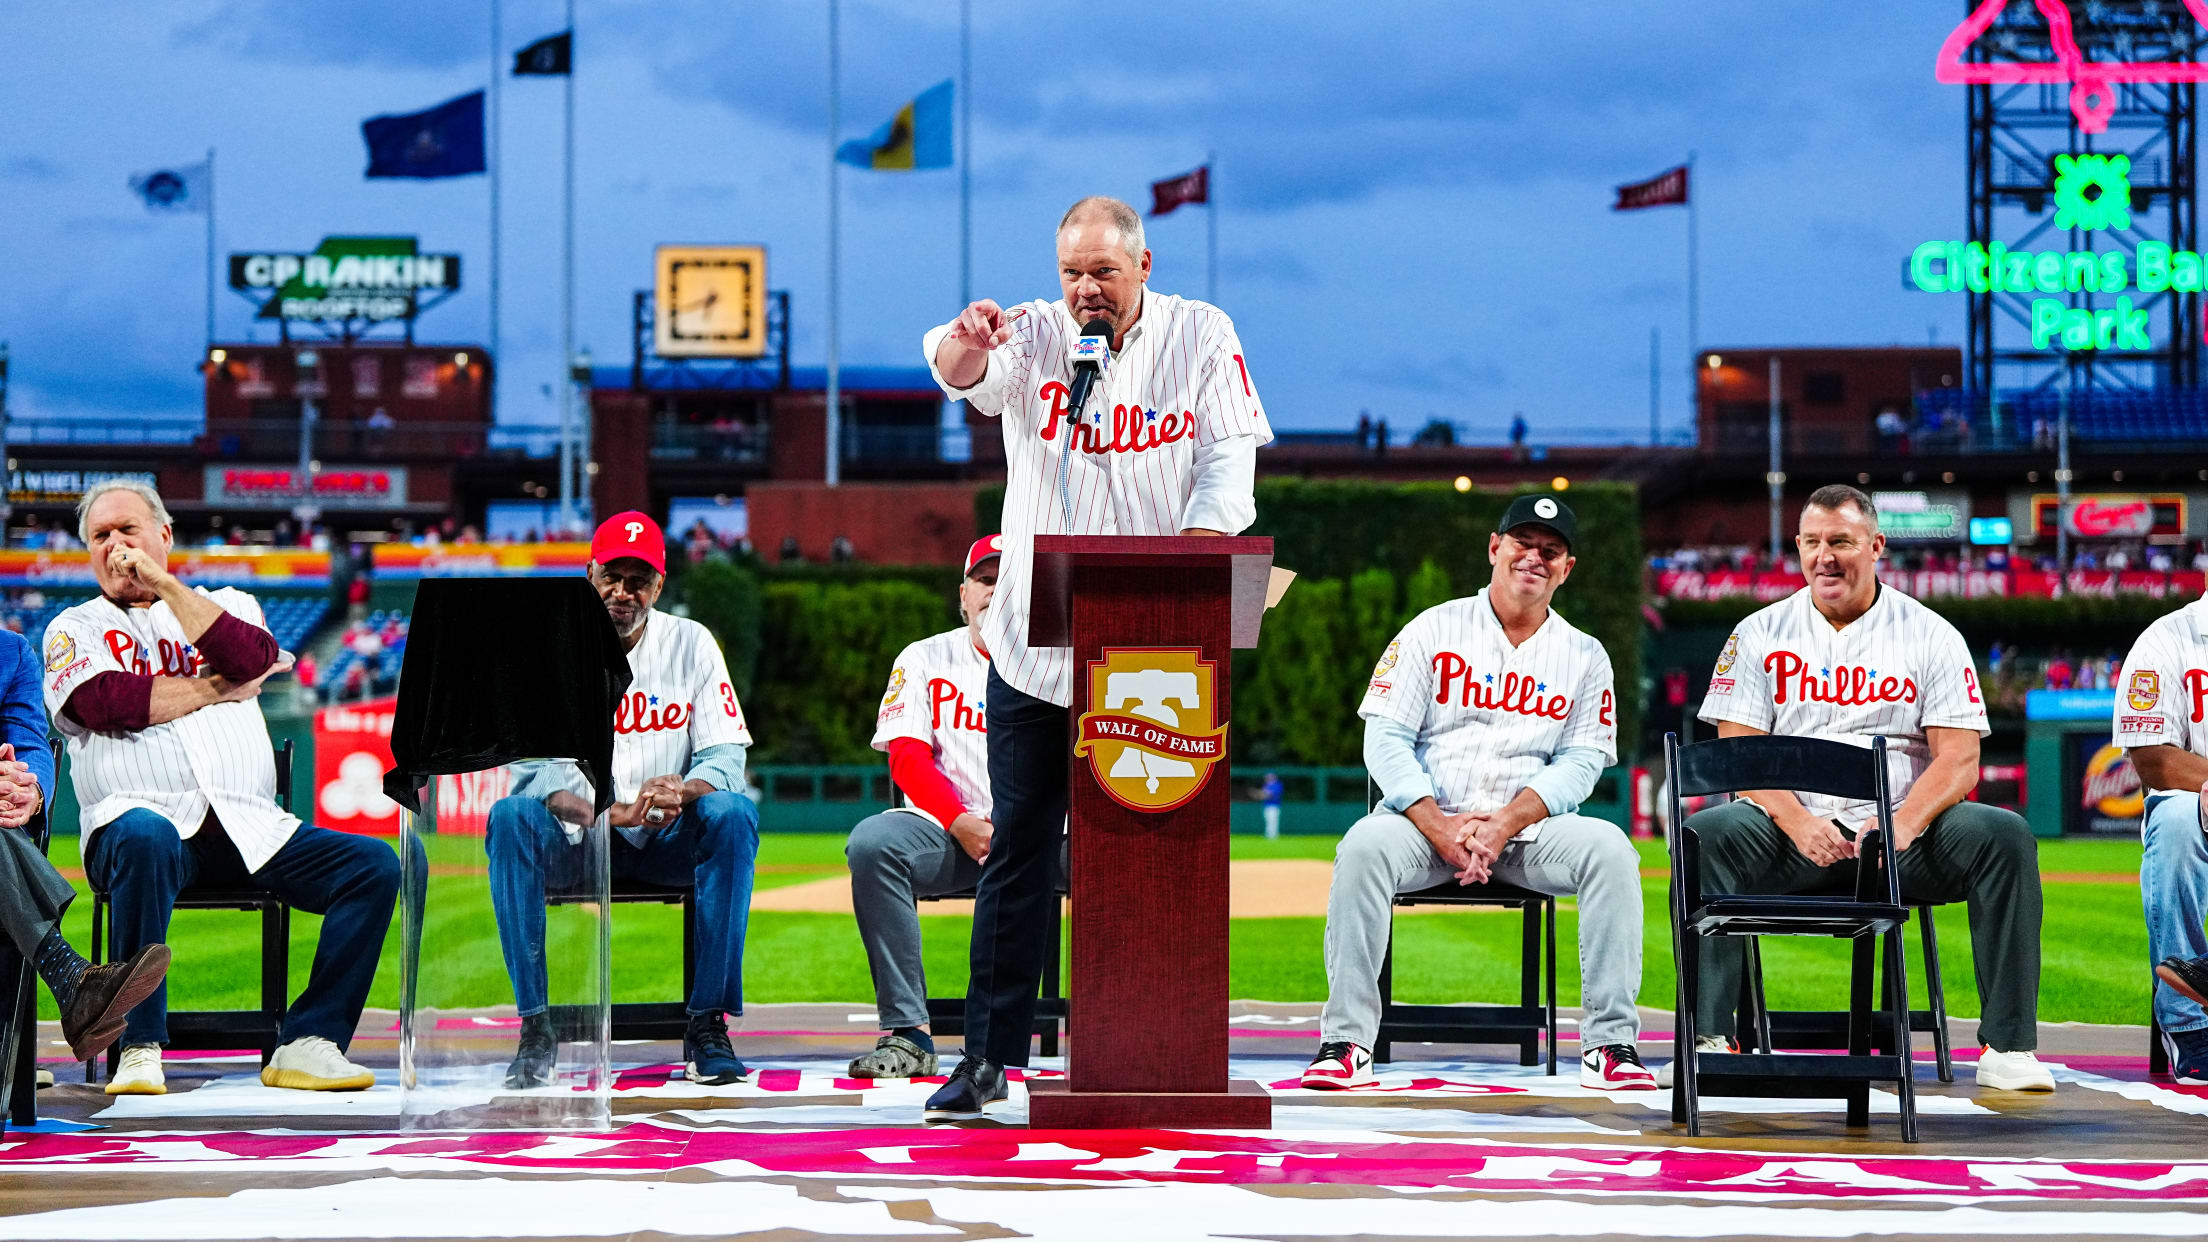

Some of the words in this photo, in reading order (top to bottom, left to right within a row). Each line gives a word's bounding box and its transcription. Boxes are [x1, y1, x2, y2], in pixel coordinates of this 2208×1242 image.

[1911, 240, 2128, 293] Citizens
[2136, 240, 2208, 293] Ba
[2032, 296, 2151, 350] Park
[1040, 380, 1194, 454] Phillies
[624, 521, 645, 543] P
[1432, 651, 1574, 721] Phillie
[1764, 650, 1917, 706] Phillies
[1094, 721, 1140, 738] WALL
[1144, 729, 1168, 746] OF
[1169, 736, 1216, 753] FAME
